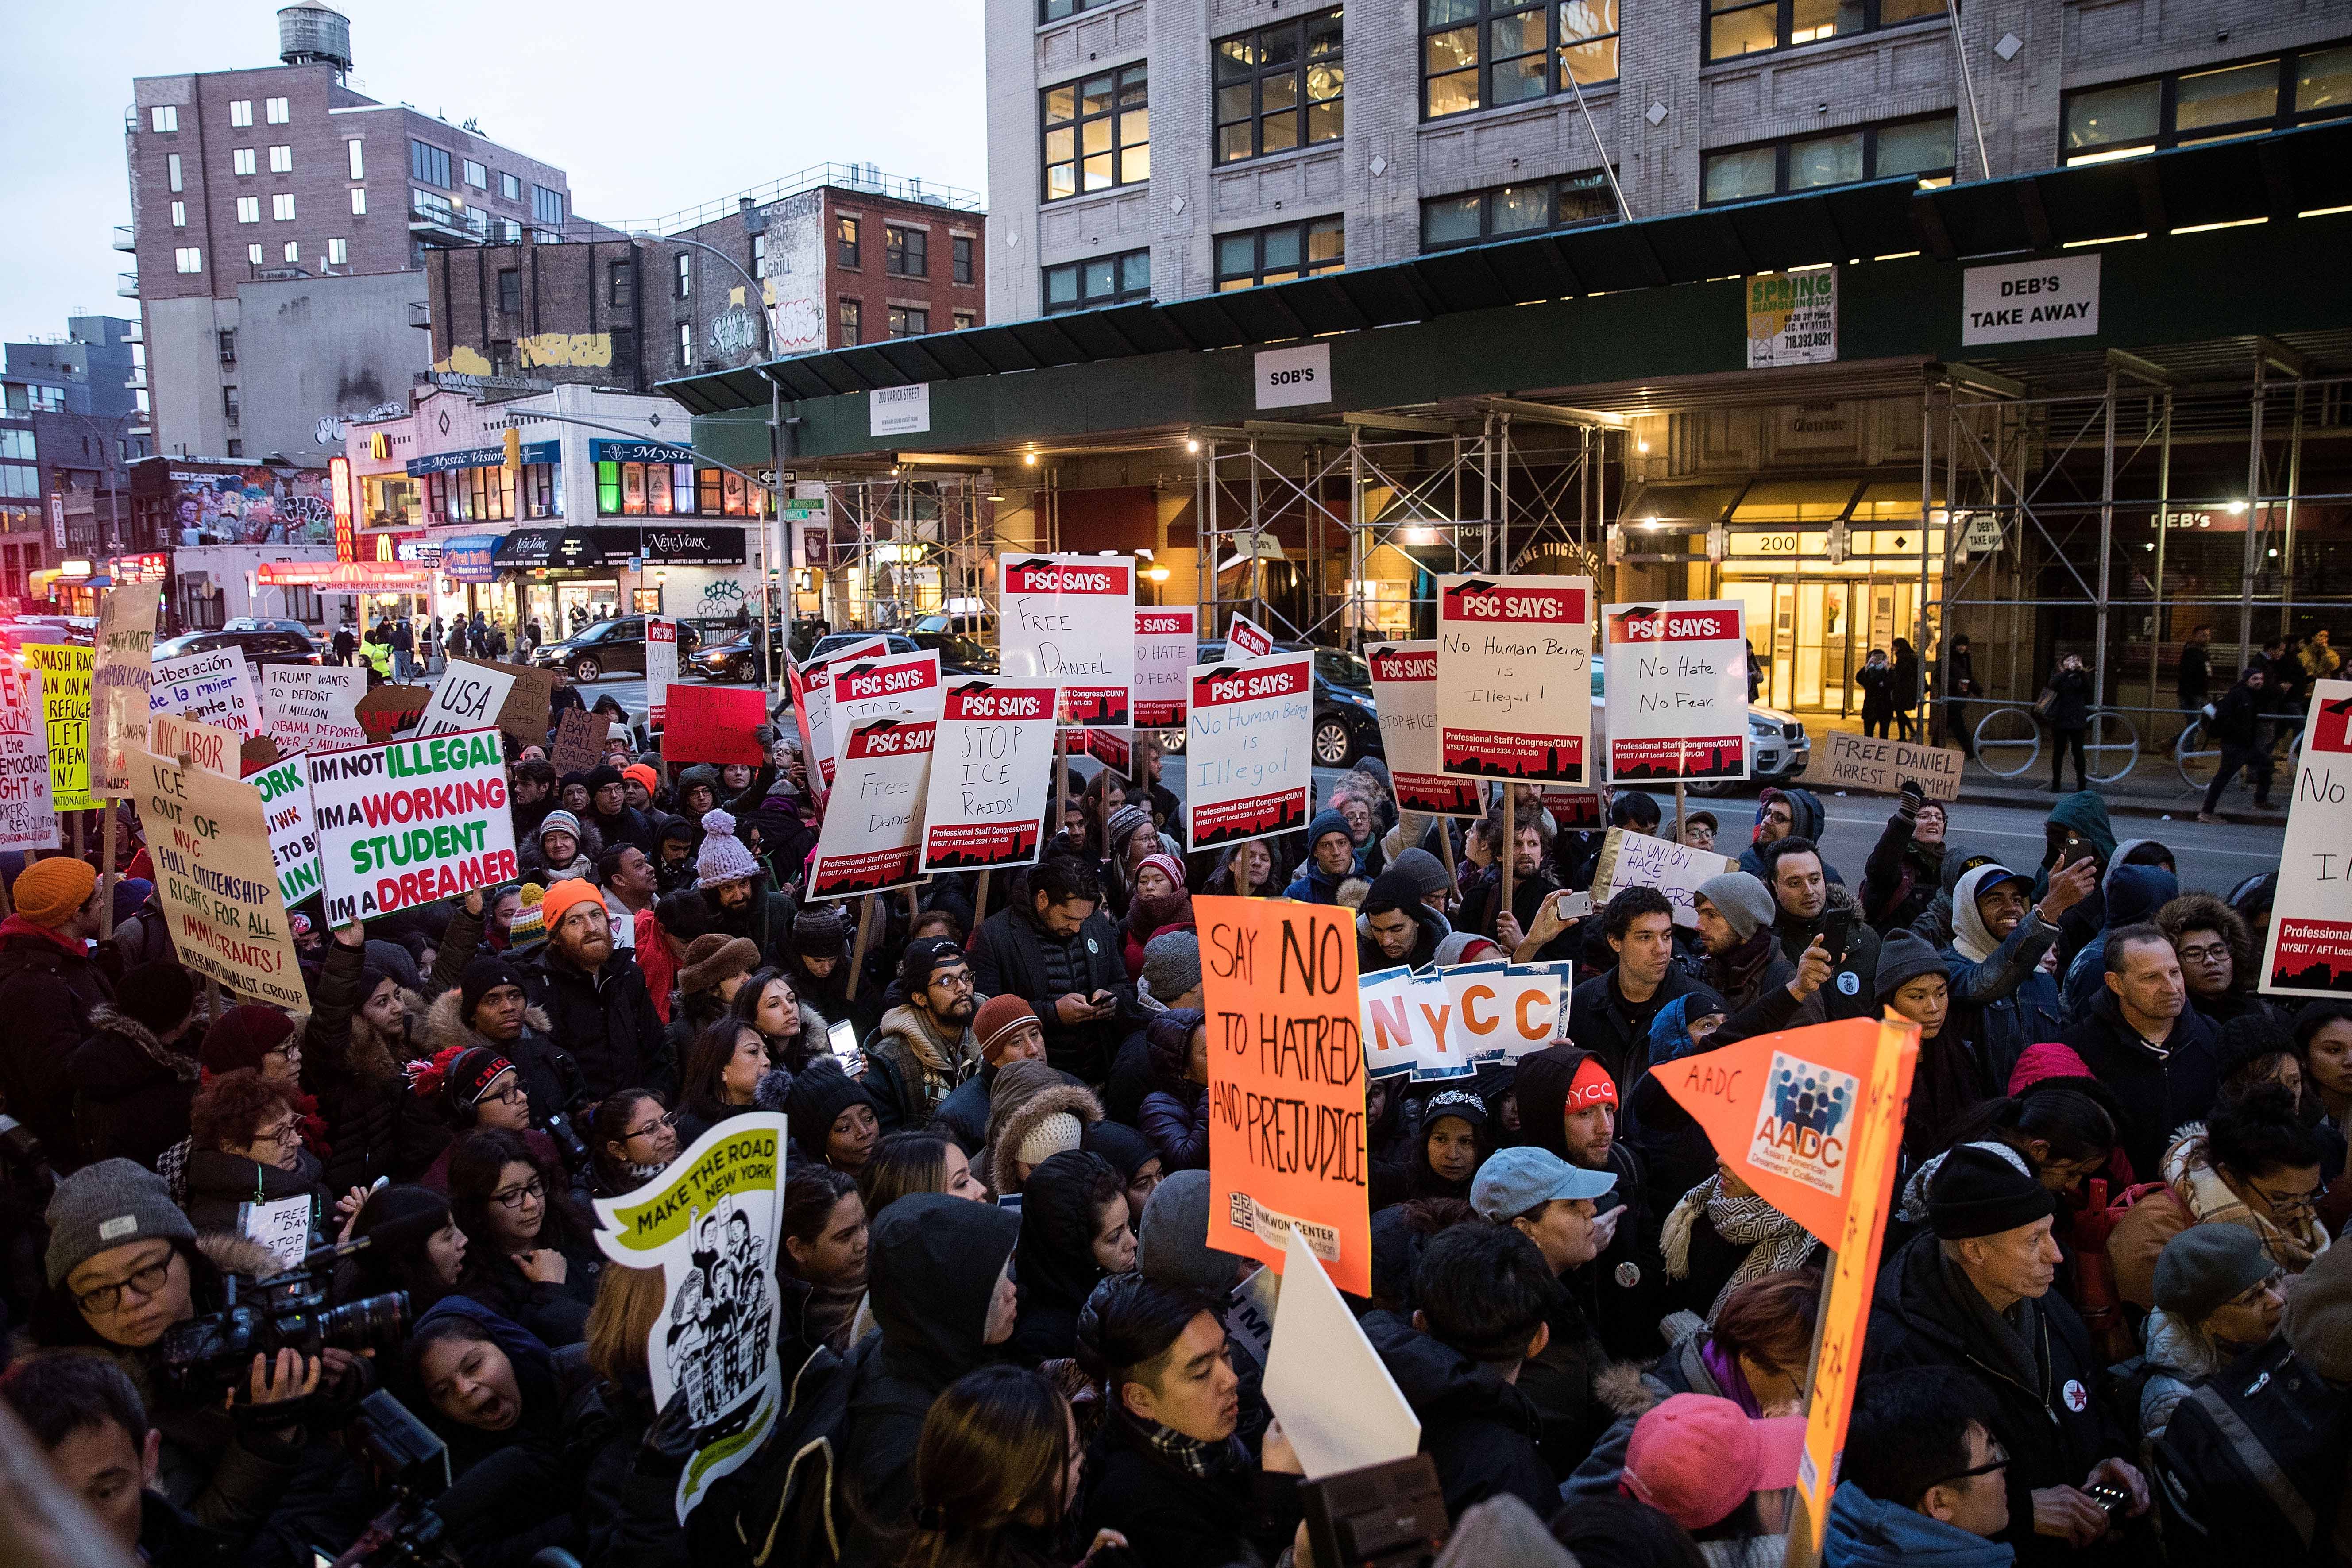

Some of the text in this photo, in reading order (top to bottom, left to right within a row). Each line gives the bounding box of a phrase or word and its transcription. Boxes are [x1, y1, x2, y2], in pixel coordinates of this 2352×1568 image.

[769, 259, 792, 278] GRILL
[1753, 274, 1831, 302] SPRING
[2001, 276, 2059, 297] DEB'S
[1971, 301, 2090, 328] TAKE AWAY
[1271, 368, 1314, 385] SOB'S
[887, 389, 903, 402] VARICK
[904, 387, 919, 400] STREET
[431, 451, 466, 469] Mystic
[54, 502, 66, 547] PIZZA
[1761, 537, 1795, 550] 200
[1024, 572, 1110, 591] PSC SAYS:
[1463, 596, 1563, 618] PSC SAYS:
[1628, 618, 1721, 638] PSC SAYS:
[1237, 628, 1266, 655] PSC SAYS:
[1443, 633, 1585, 670] No Human Being
[151, 655, 232, 686] Liberación
[1039, 642, 1112, 676] DANIEL
[1497, 663, 1513, 676] is
[65, 678, 79, 696] ON
[272, 671, 348, 687] TRUMP WANTS
[150, 695, 169, 709] de
[174, 687, 189, 702] la
[196, 677, 237, 697] mujer
[231, 695, 244, 708] la
[270, 688, 333, 702] TO DEPORT
[441, 677, 492, 721] USA
[1639, 693, 1668, 713] No
[289, 705, 328, 719] MILLION
[570, 709, 592, 722] NO
[1191, 702, 1308, 738] No Human Being
[52, 722, 82, 745] LET
[157, 720, 177, 758] NYC
[272, 721, 365, 738] OBAMA DEPORTED
[566, 721, 591, 737] BAN
[1446, 732, 1579, 748] Professional Staff Congress/CUNY
[6, 736, 23, 753] the
[308, 738, 315, 748] 5
[563, 734, 592, 752] WALL
[961, 725, 1022, 759] STOP
[1243, 735, 1257, 750] is
[52, 748, 85, 765] THEM
[312, 734, 502, 783] IM NOT ILLEGAL
[559, 747, 595, 765] RAIDS
[1834, 737, 1955, 774] FREE DANIEL
[53, 767, 73, 788] IN!
[961, 763, 1010, 786] ICE
[1197, 748, 1288, 788] Illegal
[1833, 761, 1886, 784] ARREST
[34, 784, 43, 797] for
[153, 764, 188, 801] ICE
[861, 772, 910, 799] Free
[2301, 767, 2345, 803] No
[317, 805, 344, 830] IM
[348, 803, 363, 826] A
[362, 778, 506, 828] WORKING
[152, 796, 220, 840] OUT OF
[173, 827, 200, 858] NYC
[350, 820, 487, 874] STUDENT
[1625, 835, 1692, 869] LA UNIÓN
[158, 846, 189, 879] FULL
[193, 864, 270, 905] CITIZENSHIP
[1628, 856, 1664, 878] HACE
[330, 849, 518, 922] IM A DREAMER
[169, 877, 276, 936] RIGHTS FOR ALL
[1210, 915, 1343, 996] SAY NO
[1218, 1011, 1360, 1088] TO HATRED
[1685, 1064, 1742, 1103] AADC
[1213, 1080, 1366, 1187] AND PREJUDICE
[1757, 1116, 1843, 1168] AADC
[1763, 1147, 1826, 1176] Asian American
[638, 1139, 775, 1235] MAKE THE ROAD
[704, 1164, 773, 1202] NEW YORK
[274, 1206, 308, 1223] FREE
[269, 1234, 304, 1250] STOP
[280, 1246, 303, 1258] ICE
